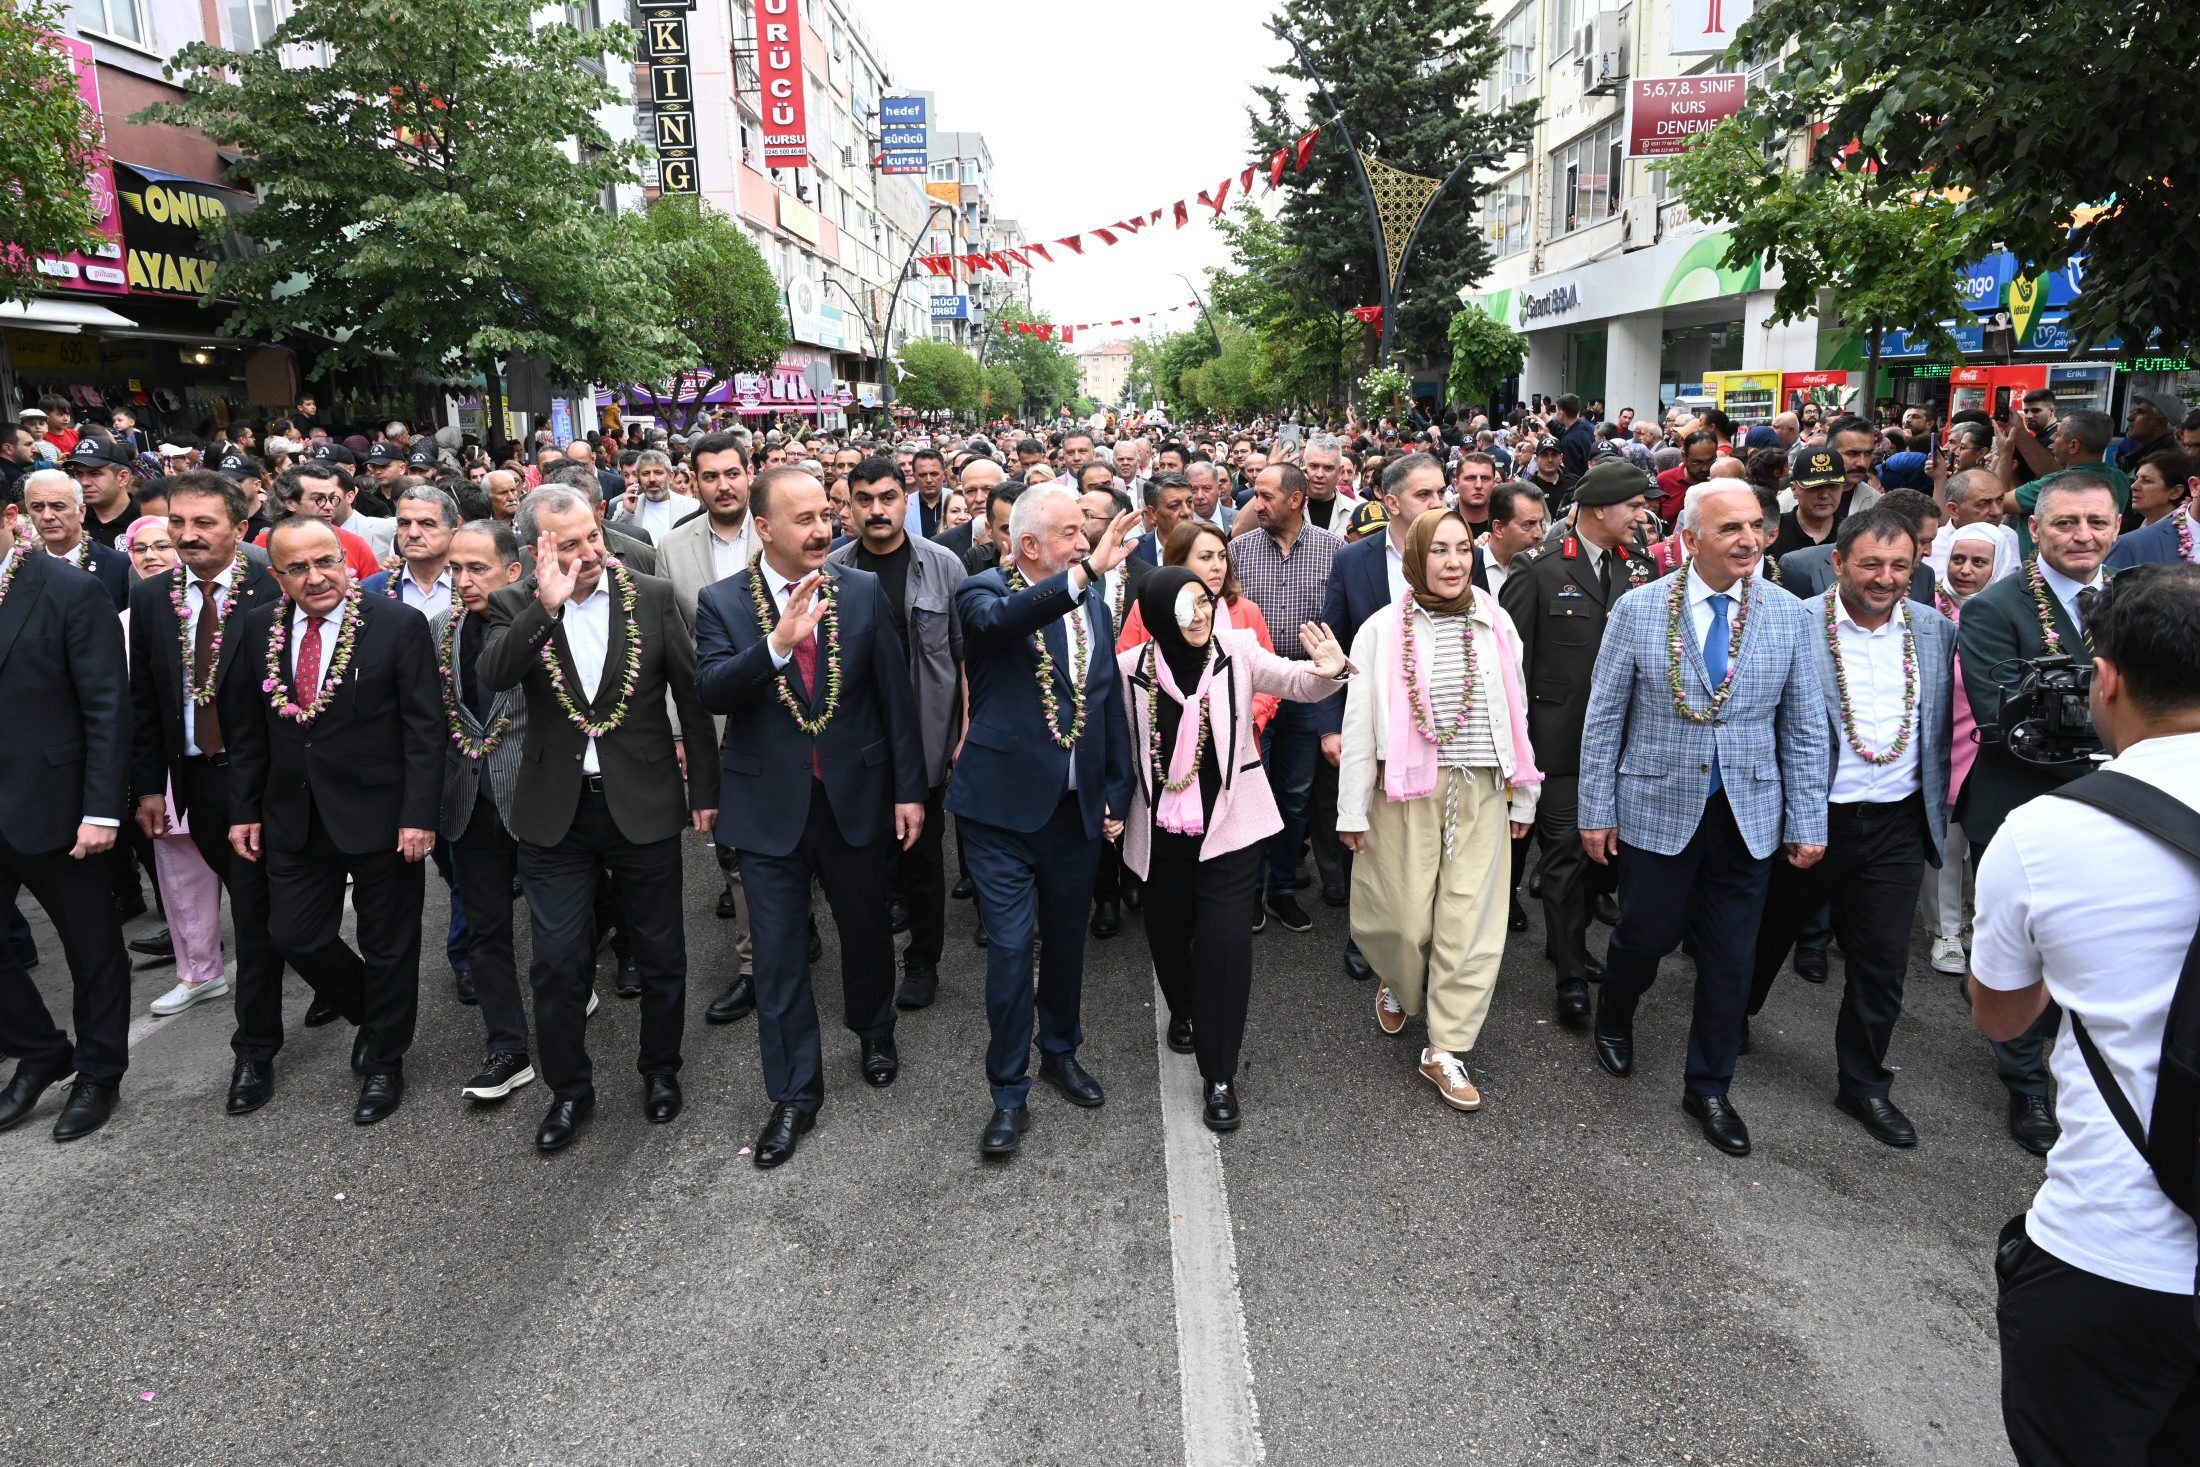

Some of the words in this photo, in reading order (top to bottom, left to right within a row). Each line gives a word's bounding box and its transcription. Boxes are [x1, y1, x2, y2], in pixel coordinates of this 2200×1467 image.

[1642, 81, 1694, 98] 5,6,7,8.
[1699, 79, 1736, 94] SINIF
[652, 22, 691, 190] KING
[885, 105, 920, 116] hedef
[1671, 100, 1706, 114] KURS
[764, 134, 806, 145] KURSU
[884, 133, 924, 144] sürücü
[886, 155, 923, 166] kursu
[127, 248, 218, 293] AYAKK
[930, 296, 960, 307] RÜCÜ
[930, 306, 957, 316] URSU
[2013, 305, 2031, 316] iddaa
[2135, 357, 2191, 371] FUTBOL
[2066, 369, 2087, 378] Erikli
